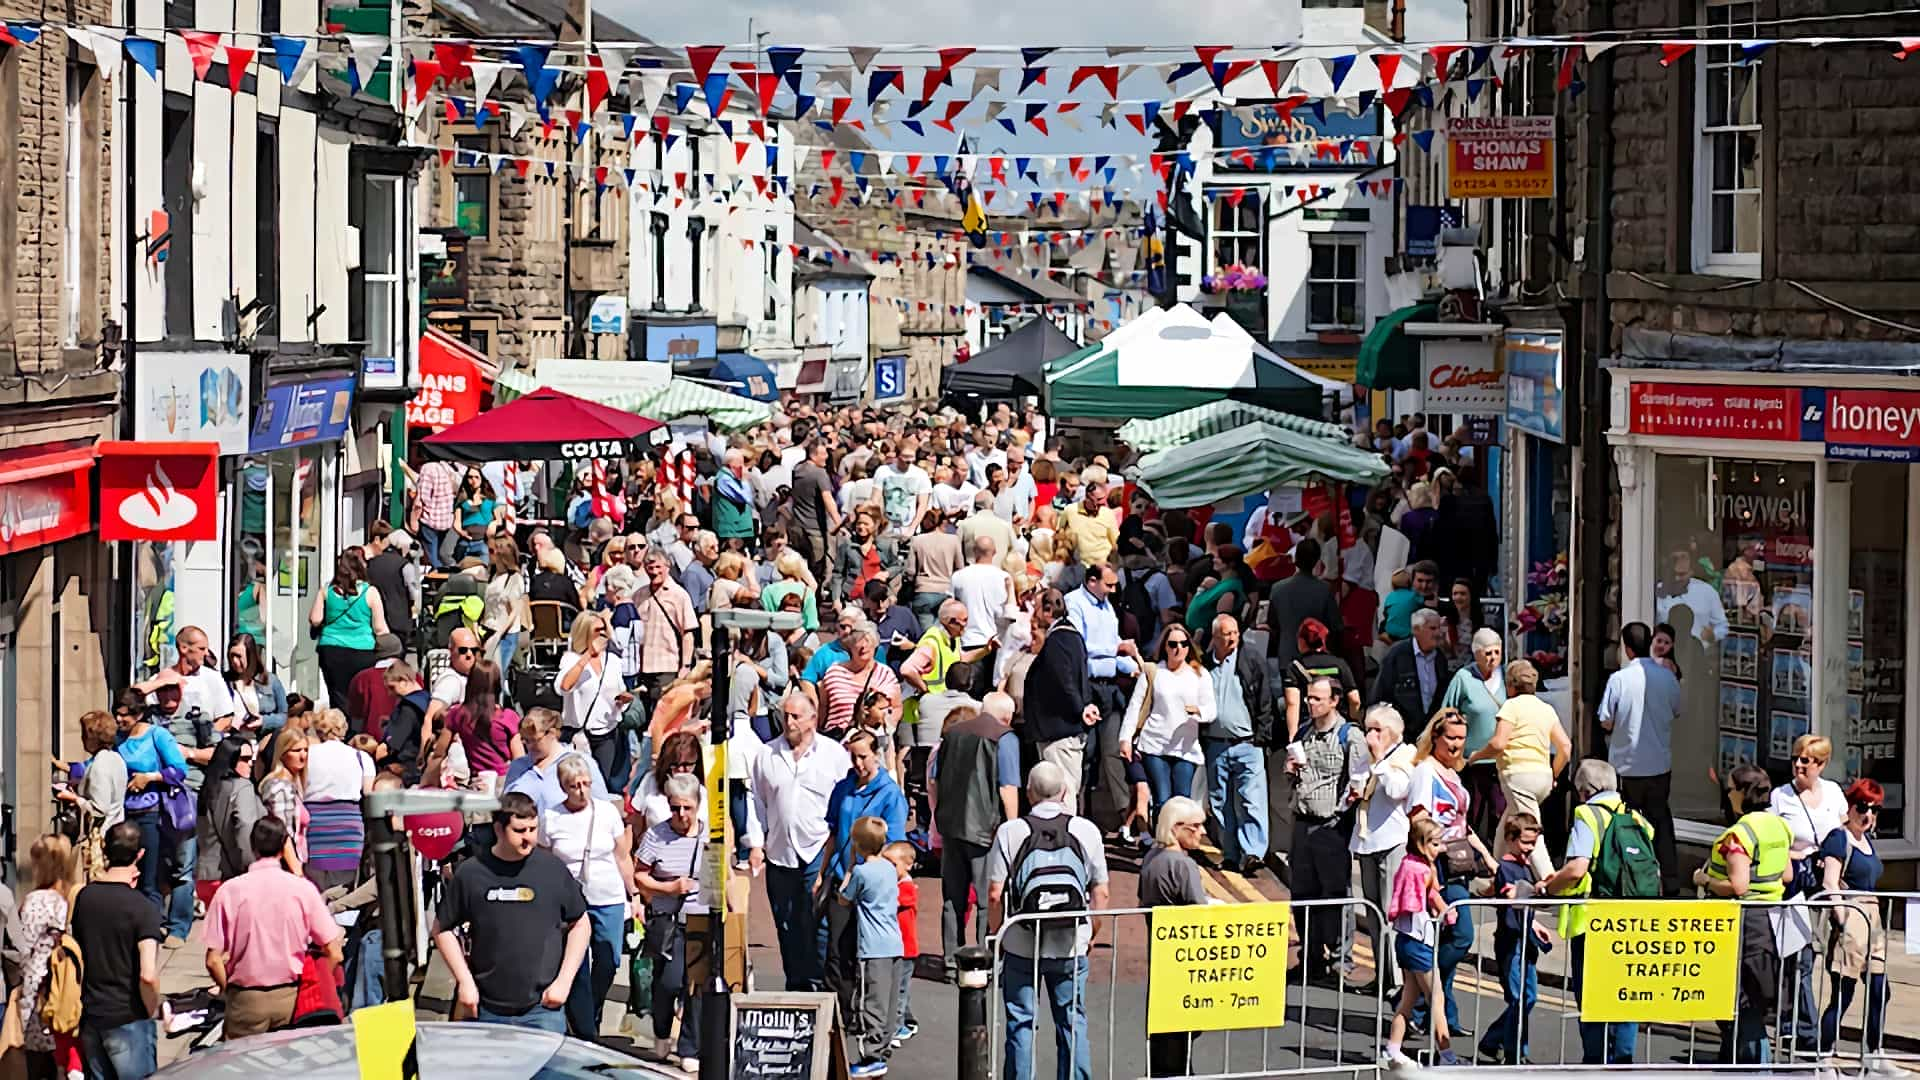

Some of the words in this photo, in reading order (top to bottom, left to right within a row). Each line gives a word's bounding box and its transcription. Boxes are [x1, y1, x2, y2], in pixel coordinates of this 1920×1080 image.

[1460, 141, 1541, 155] THOMAS
[1473, 156, 1528, 171] SHAW
[418, 373, 467, 393] ANS
[1640, 393, 1674, 407] chartered
[1676, 395, 1714, 409] surveyors
[1724, 397, 1750, 409] estate
[1754, 398, 1783, 412] agents
[1640, 413, 1783, 431] www.honeywell.co.uk
[560, 440, 623, 458] COSTA
[1830, 446, 1869, 458] chartered
[1871, 447, 1911, 460] surveyors
[1863, 743, 1896, 760] FEE
[418, 826, 452, 838] COSTA
[1156, 925, 1218, 940] CASTLE
[1224, 922, 1285, 938] STREET
[1590, 918, 1660, 932] CASTLE
[1667, 918, 1735, 932] STREET
[1175, 946, 1240, 962] CLOSED
[1247, 943, 1267, 959] TO
[1611, 940, 1686, 955] CLOSED
[1693, 940, 1716, 955] TO
[1188, 966, 1254, 983] TRAFFIC
[1625, 963, 1701, 977] TRAFFIC
[1182, 995, 1213, 1009] 6am
[1230, 993, 1259, 1009] 7pm
[1618, 987, 1653, 1001] 6am
[1671, 987, 1705, 1002] 7pm
[745, 1010, 809, 1034] Molly's
